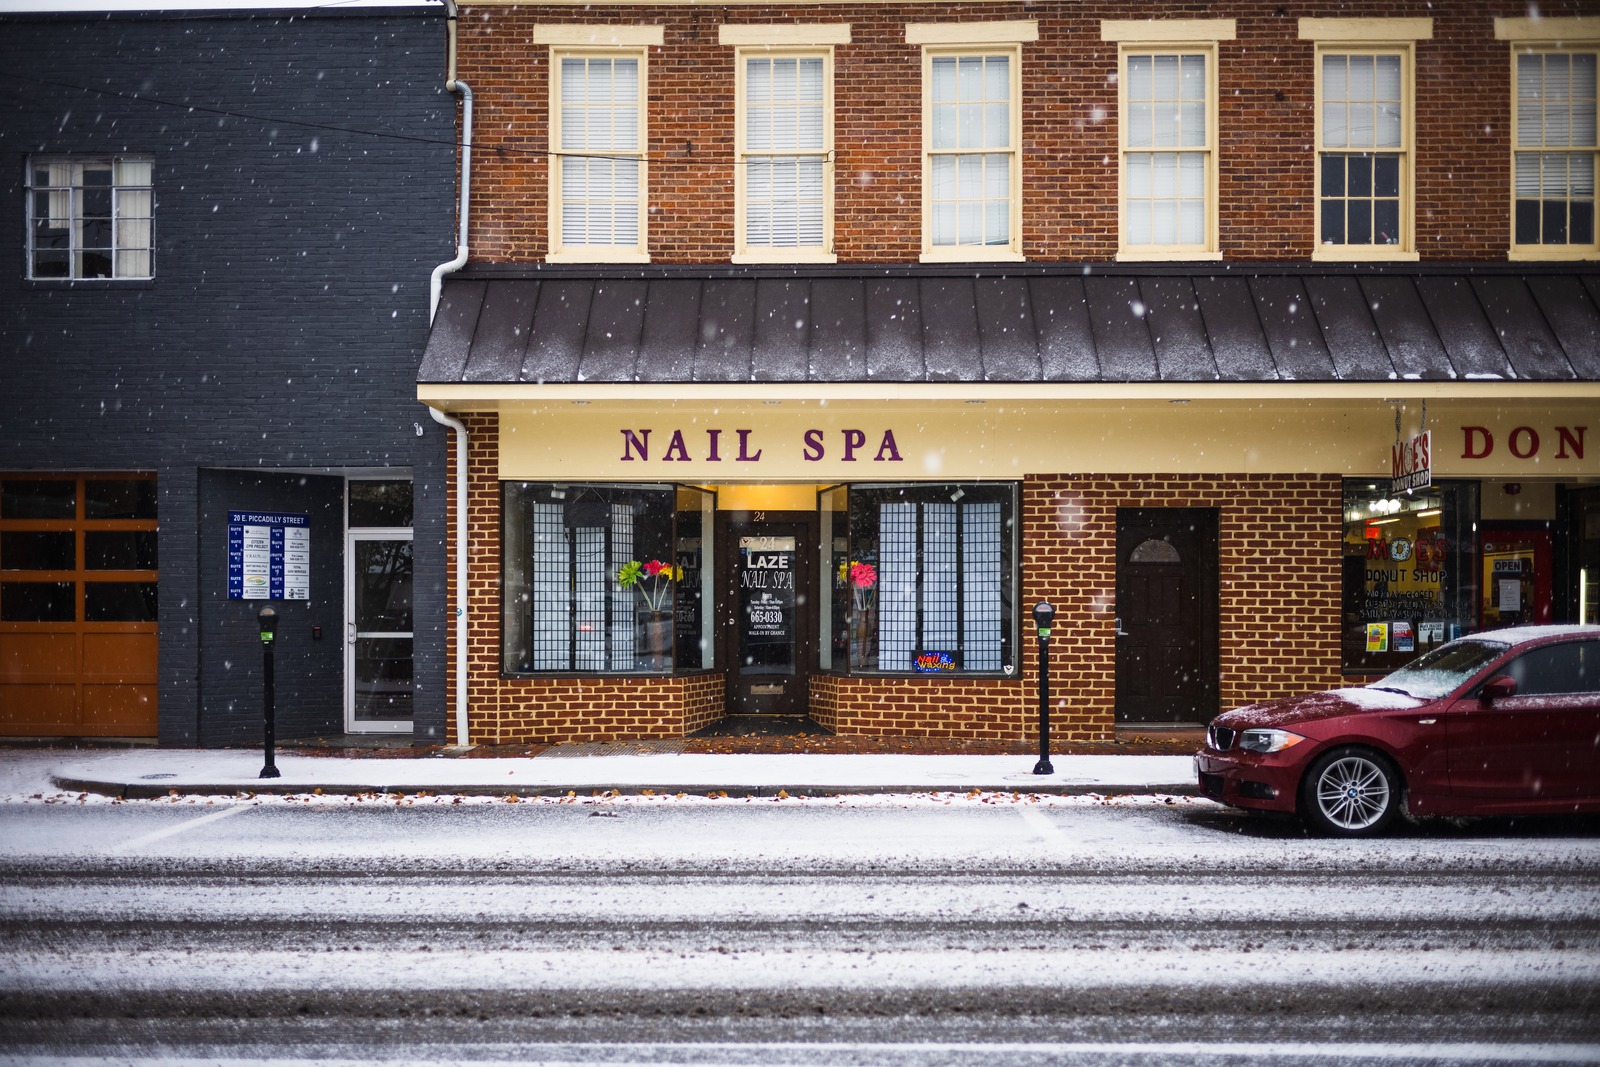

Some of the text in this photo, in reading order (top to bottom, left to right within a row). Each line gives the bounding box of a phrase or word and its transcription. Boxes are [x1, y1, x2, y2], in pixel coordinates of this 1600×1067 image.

[620, 429, 904, 462] NAIL SPA
[1460, 426, 1588, 459] DON
[1392, 433, 1428, 479] MOE'S
[1392, 470, 1428, 492] DONUT SHOP
[248, 515, 282, 523] PICCADILLY
[754, 511, 765, 521] 24
[760, 537, 775, 550] 24
[1366, 537, 1449, 562] MOE'S
[747, 556, 788, 568] LAZE
[1495, 561, 1520, 571] OPEN
[740, 571, 792, 589] NAIL SPA
[1366, 569, 1448, 582] DONUT SHOP
[750, 610, 782, 622] 665-0330
[917, 655, 939, 663] Nail
